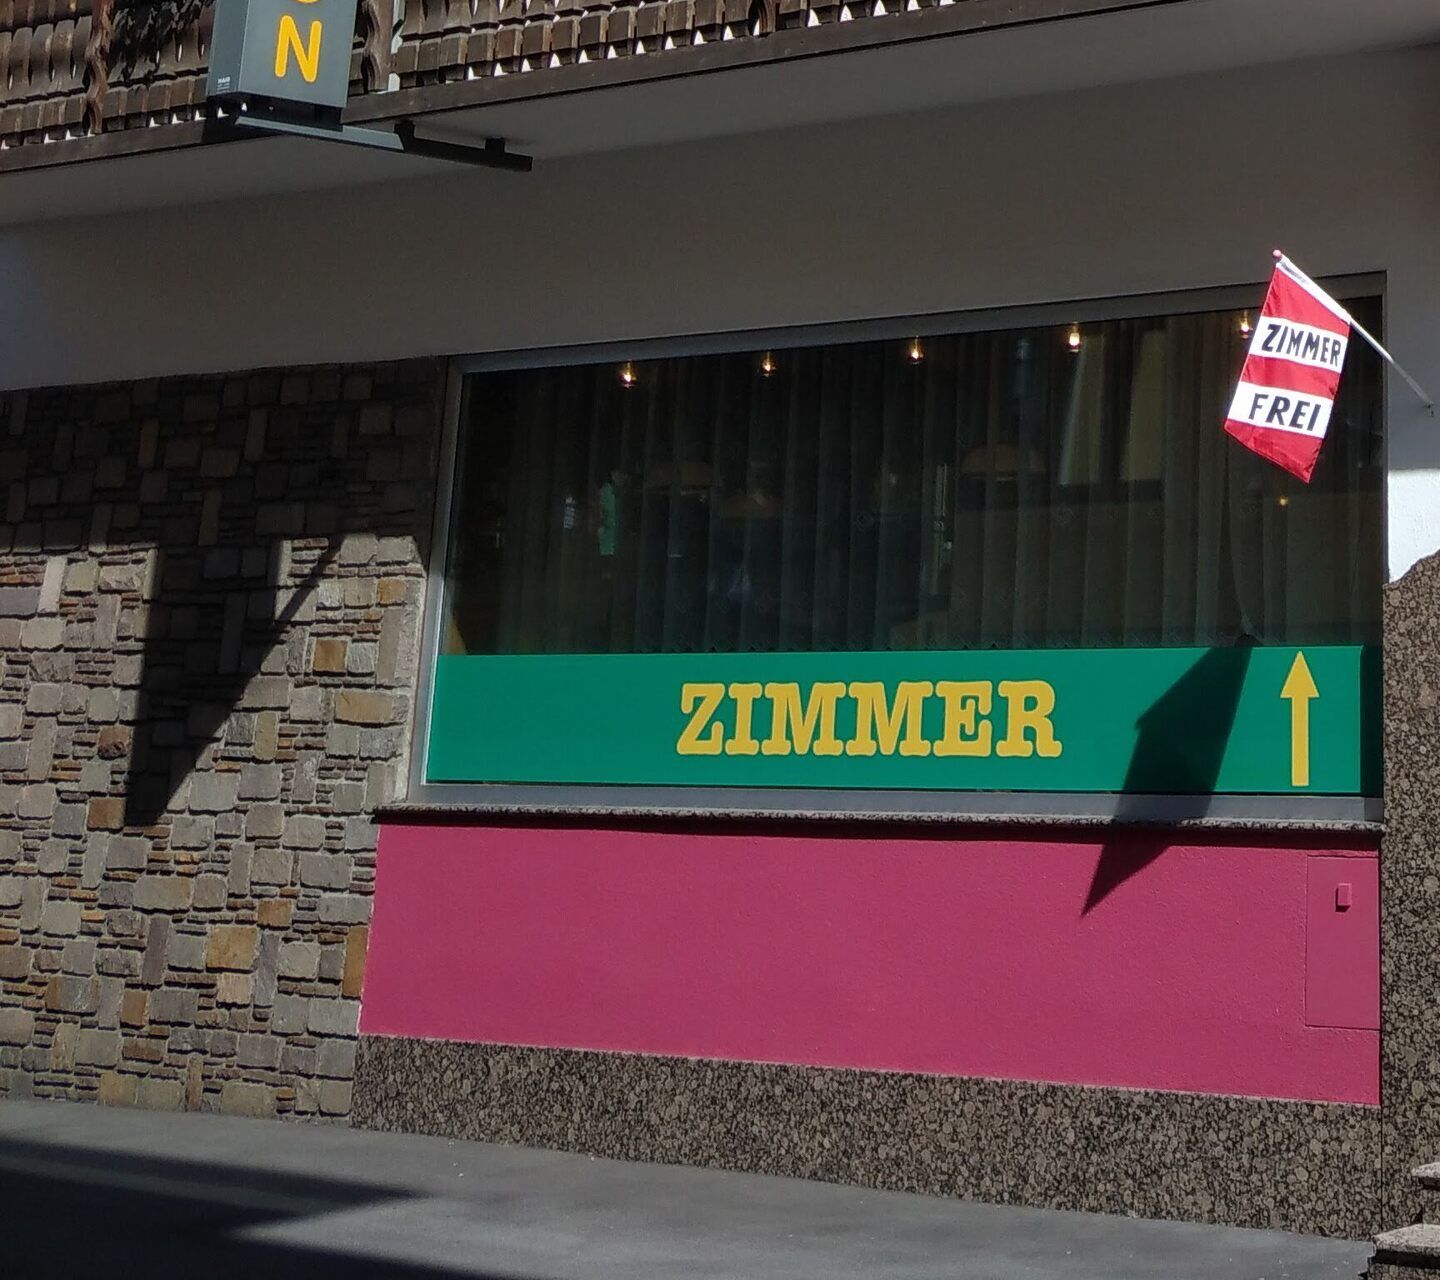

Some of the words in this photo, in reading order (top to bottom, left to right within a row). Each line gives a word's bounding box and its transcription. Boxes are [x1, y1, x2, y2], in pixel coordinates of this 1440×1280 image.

[1261, 322, 1342, 368] ZIMMER
[1249, 393, 1322, 432] FREI
[676, 680, 1063, 758] ZIMMER
